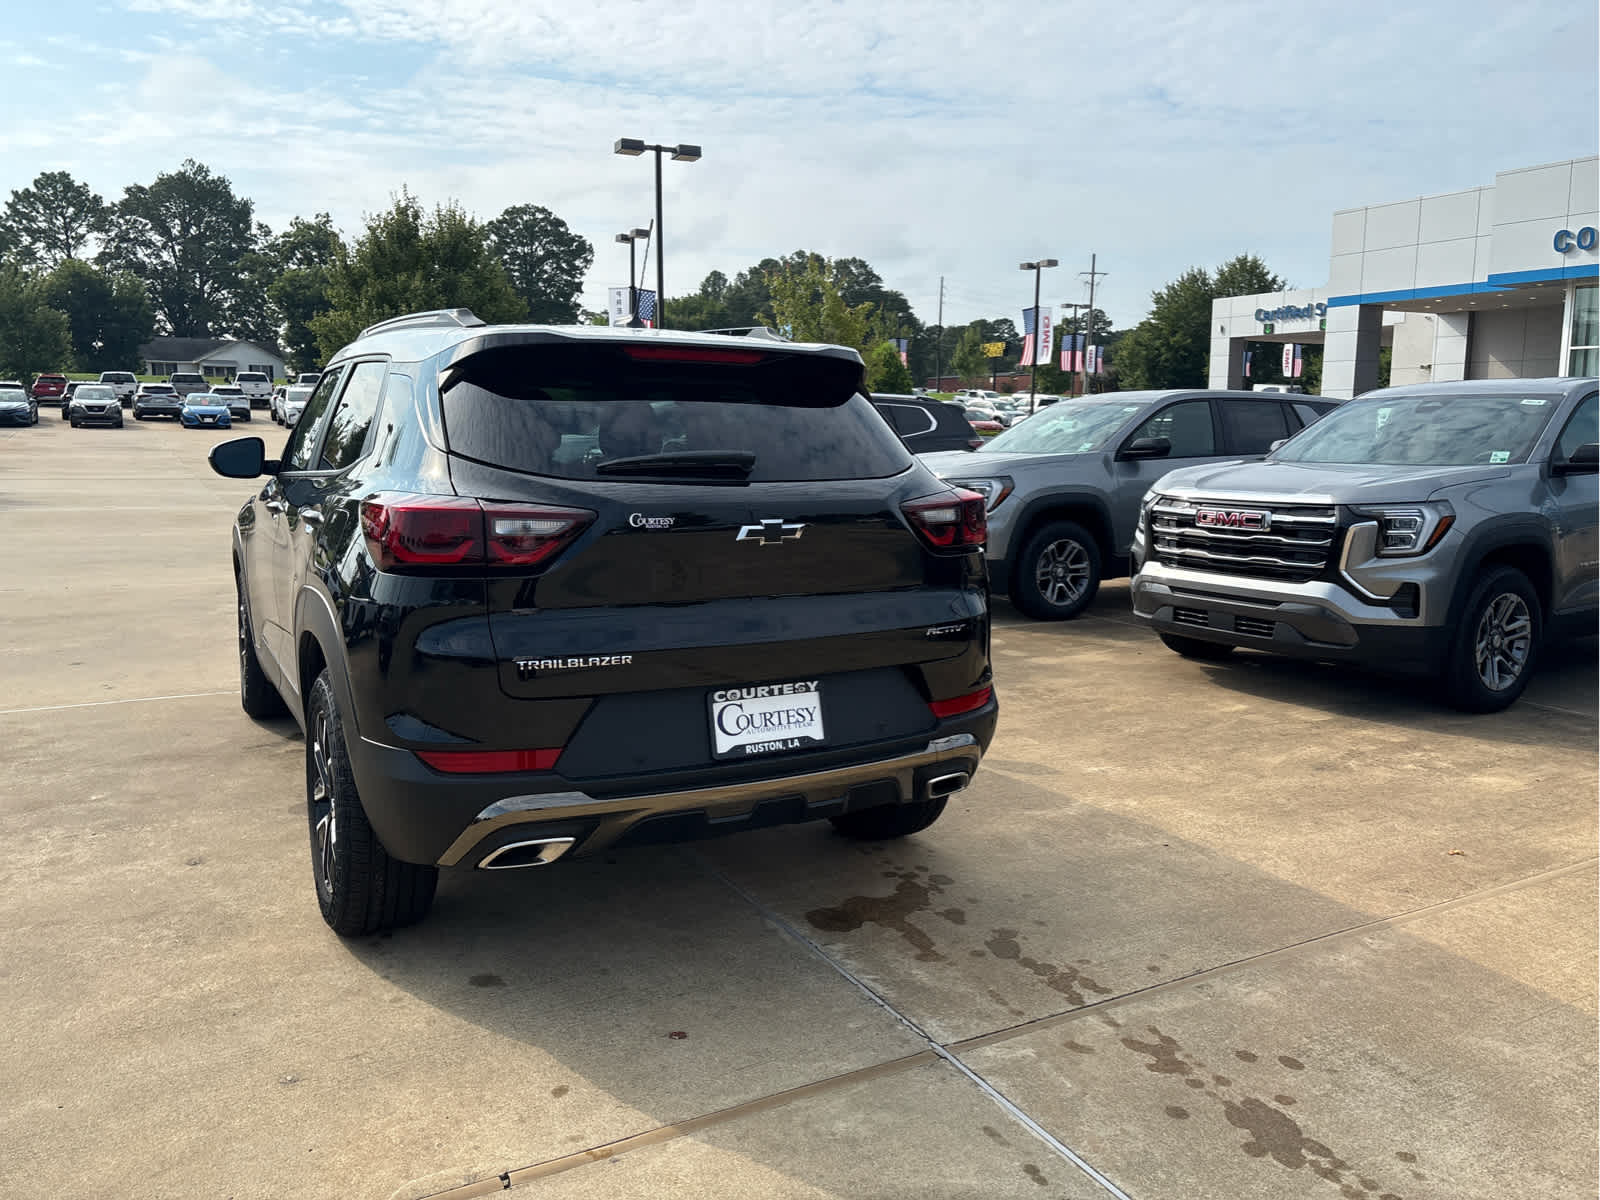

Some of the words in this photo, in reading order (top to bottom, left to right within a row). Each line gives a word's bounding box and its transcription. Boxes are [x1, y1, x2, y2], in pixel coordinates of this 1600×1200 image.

[1041, 316, 1051, 358] GMC
[1197, 509, 1262, 529] GMC
[516, 655, 632, 670] TRAILBLAZER
[713, 680, 819, 702] COURTESY
[746, 724, 792, 735] AUTOMOTIVE
[794, 721, 813, 729] TEAM
[745, 741, 786, 754] RUSTON,
[788, 739, 801, 748] LA
